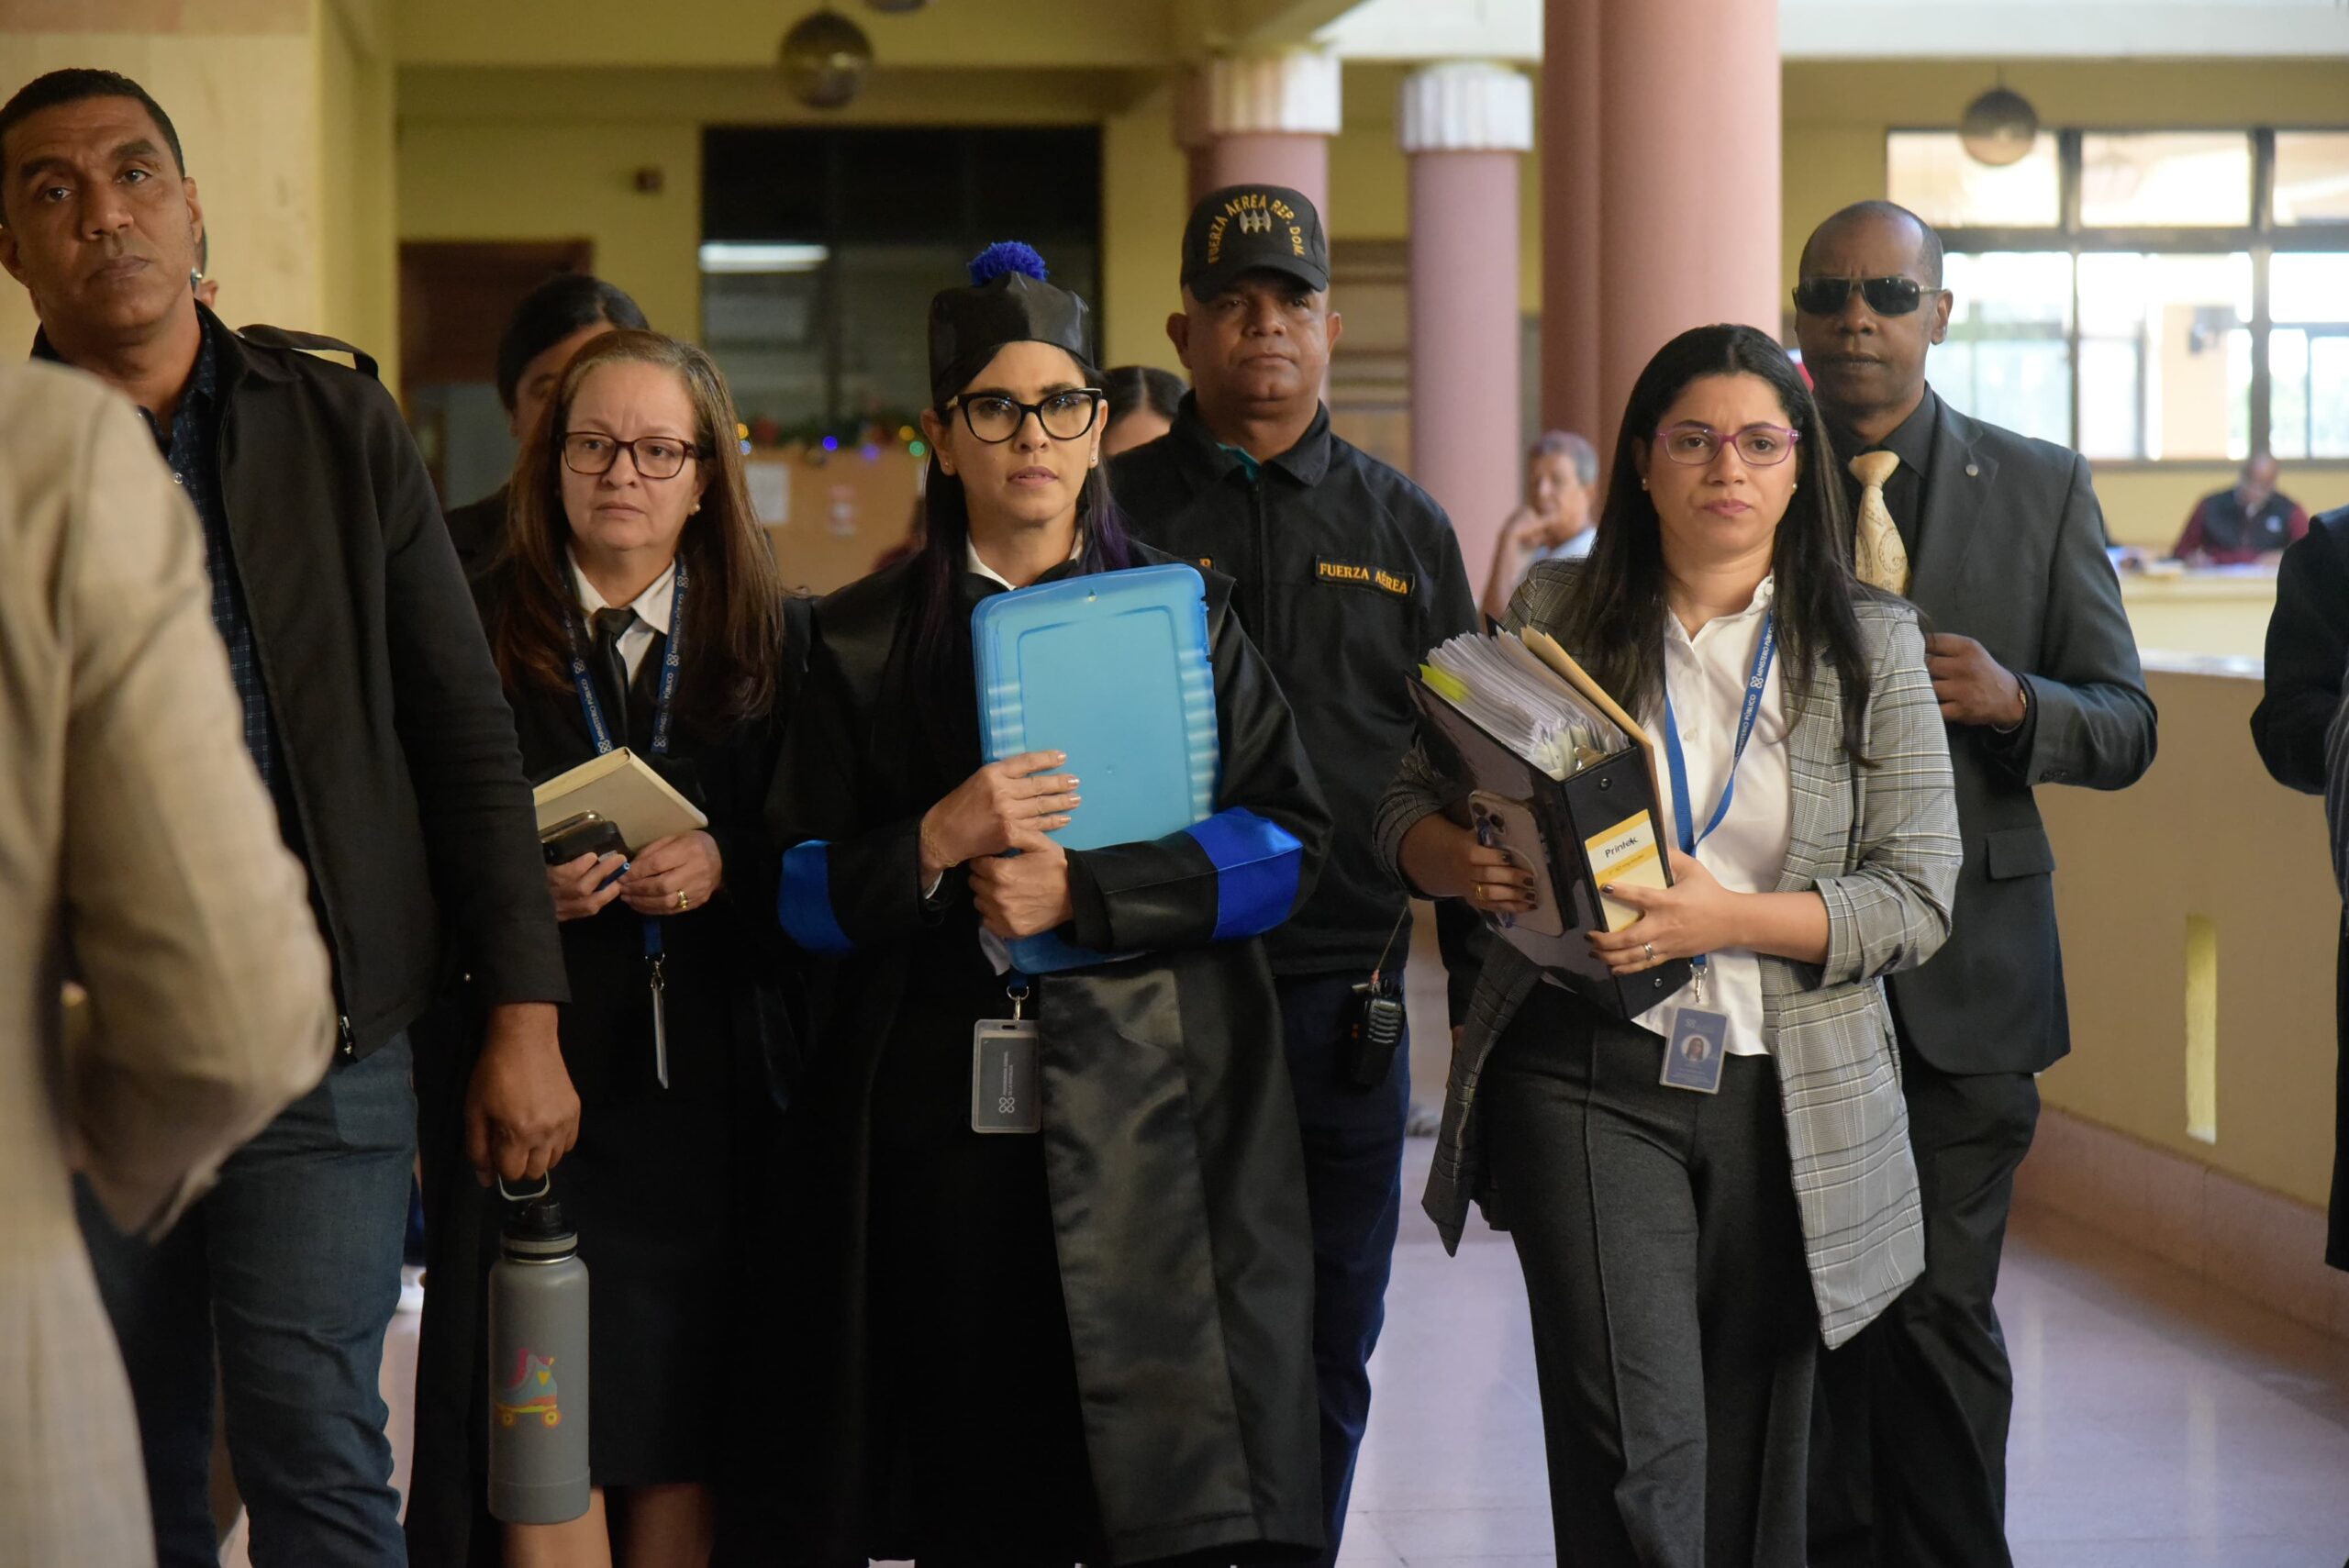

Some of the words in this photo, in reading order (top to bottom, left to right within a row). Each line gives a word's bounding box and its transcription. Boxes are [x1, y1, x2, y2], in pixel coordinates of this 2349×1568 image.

[1225, 195, 1267, 217] AEREA
[1319, 562, 1370, 580] FUERZA
[1375, 570, 1408, 595] AÉREA
[1757, 646, 1771, 678] MINISTERIO
[664, 673, 674, 699] PÚBLICO
[1744, 695, 1756, 721] PÚBLICO
[589, 706, 606, 740] MINISTERIO
[1605, 837, 1639, 858] Printek
